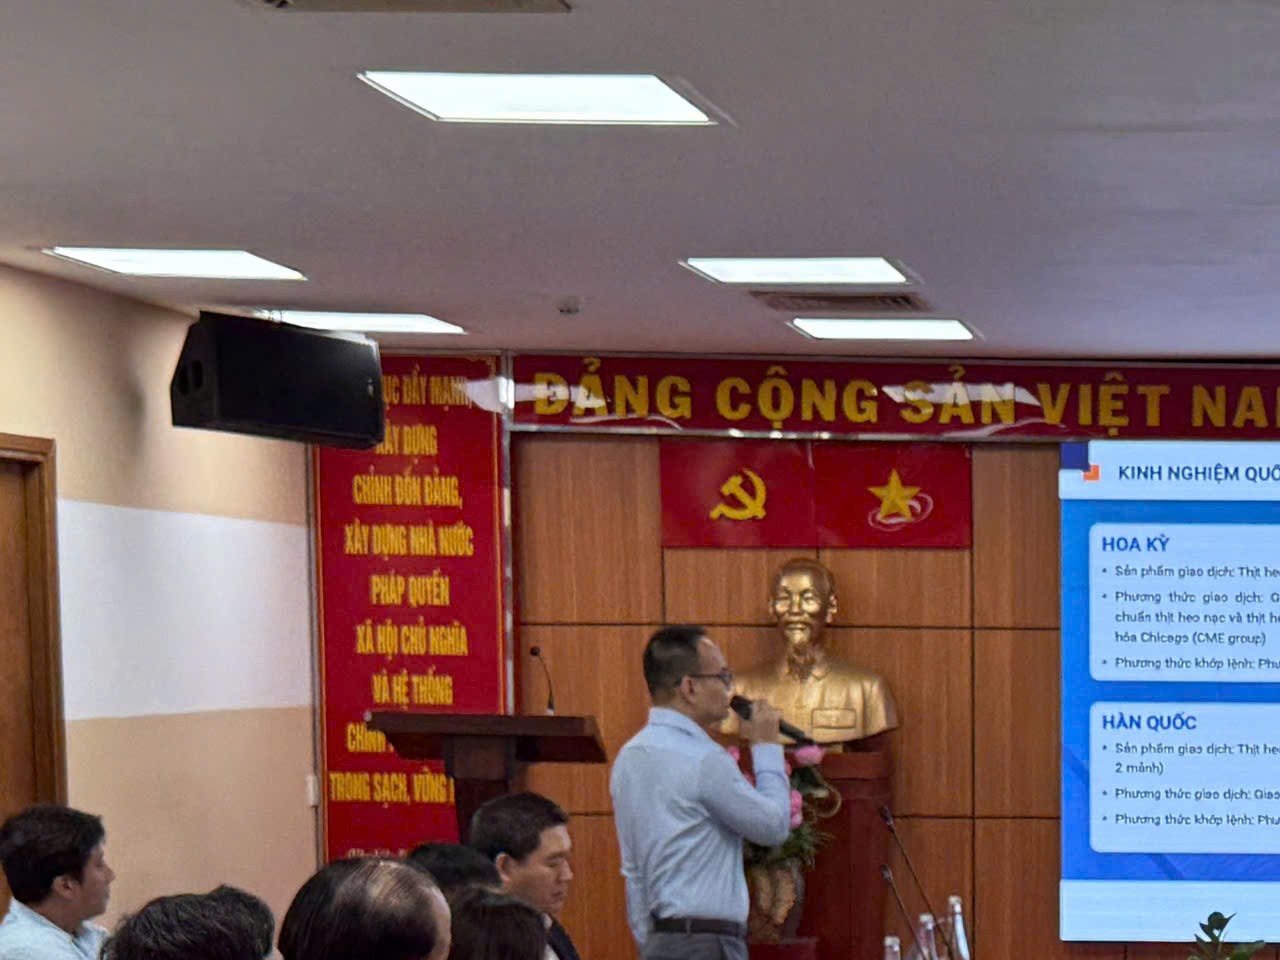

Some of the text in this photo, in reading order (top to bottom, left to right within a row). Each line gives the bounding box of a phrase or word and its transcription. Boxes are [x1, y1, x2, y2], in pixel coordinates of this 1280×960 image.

[533, 357, 693, 420] ĐẢNG
[716, 365, 879, 430] CỘNG
[901, 364, 1016, 425] SẢN
[1036, 370, 1170, 436] VIỆT
[1118, 466, 1163, 481] KINH
[1167, 463, 1240, 484] NGHIỆM
[1102, 534, 1170, 552] HOA KỲ
[1102, 712, 1197, 732] HÀN QUỐC
